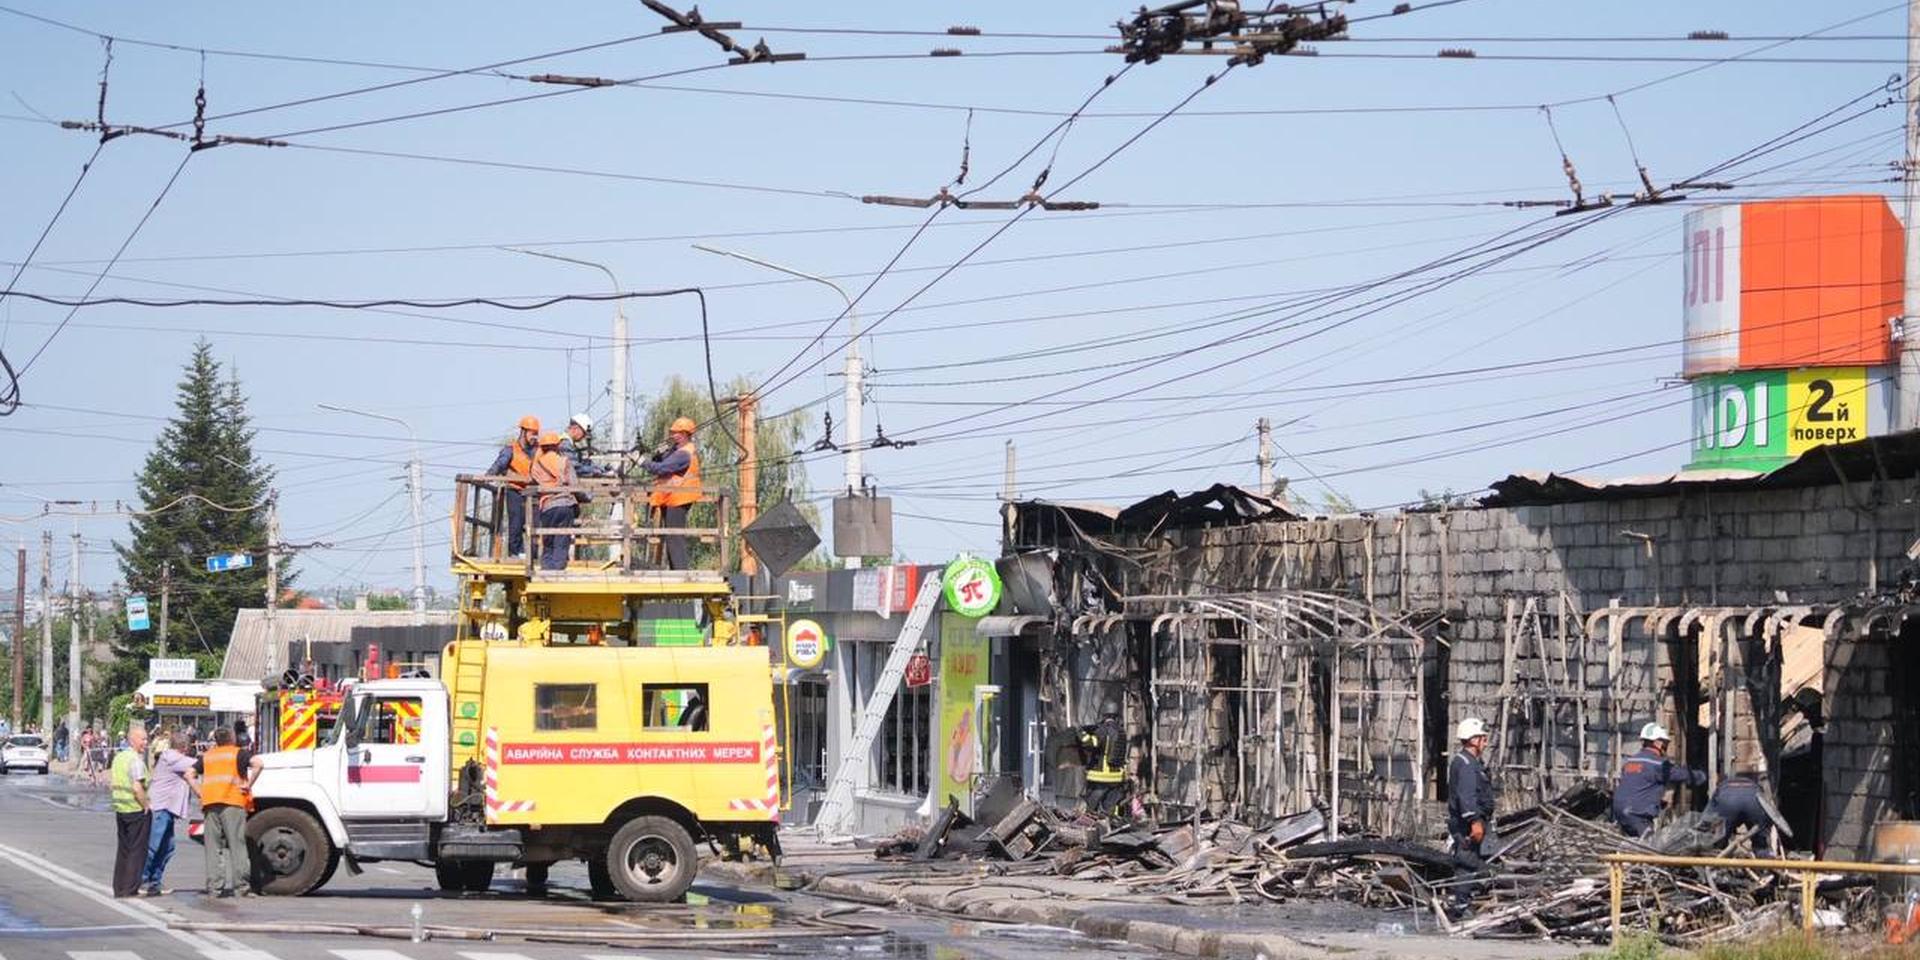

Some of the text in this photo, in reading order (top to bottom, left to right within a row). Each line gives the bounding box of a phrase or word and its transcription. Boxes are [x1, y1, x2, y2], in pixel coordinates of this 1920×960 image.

[1795, 427, 1856, 445] поверх
[507, 747, 754, 759] АВАРІЙНА СЛУЖБА КОНТАКТНИХ МЕРЕЖ
